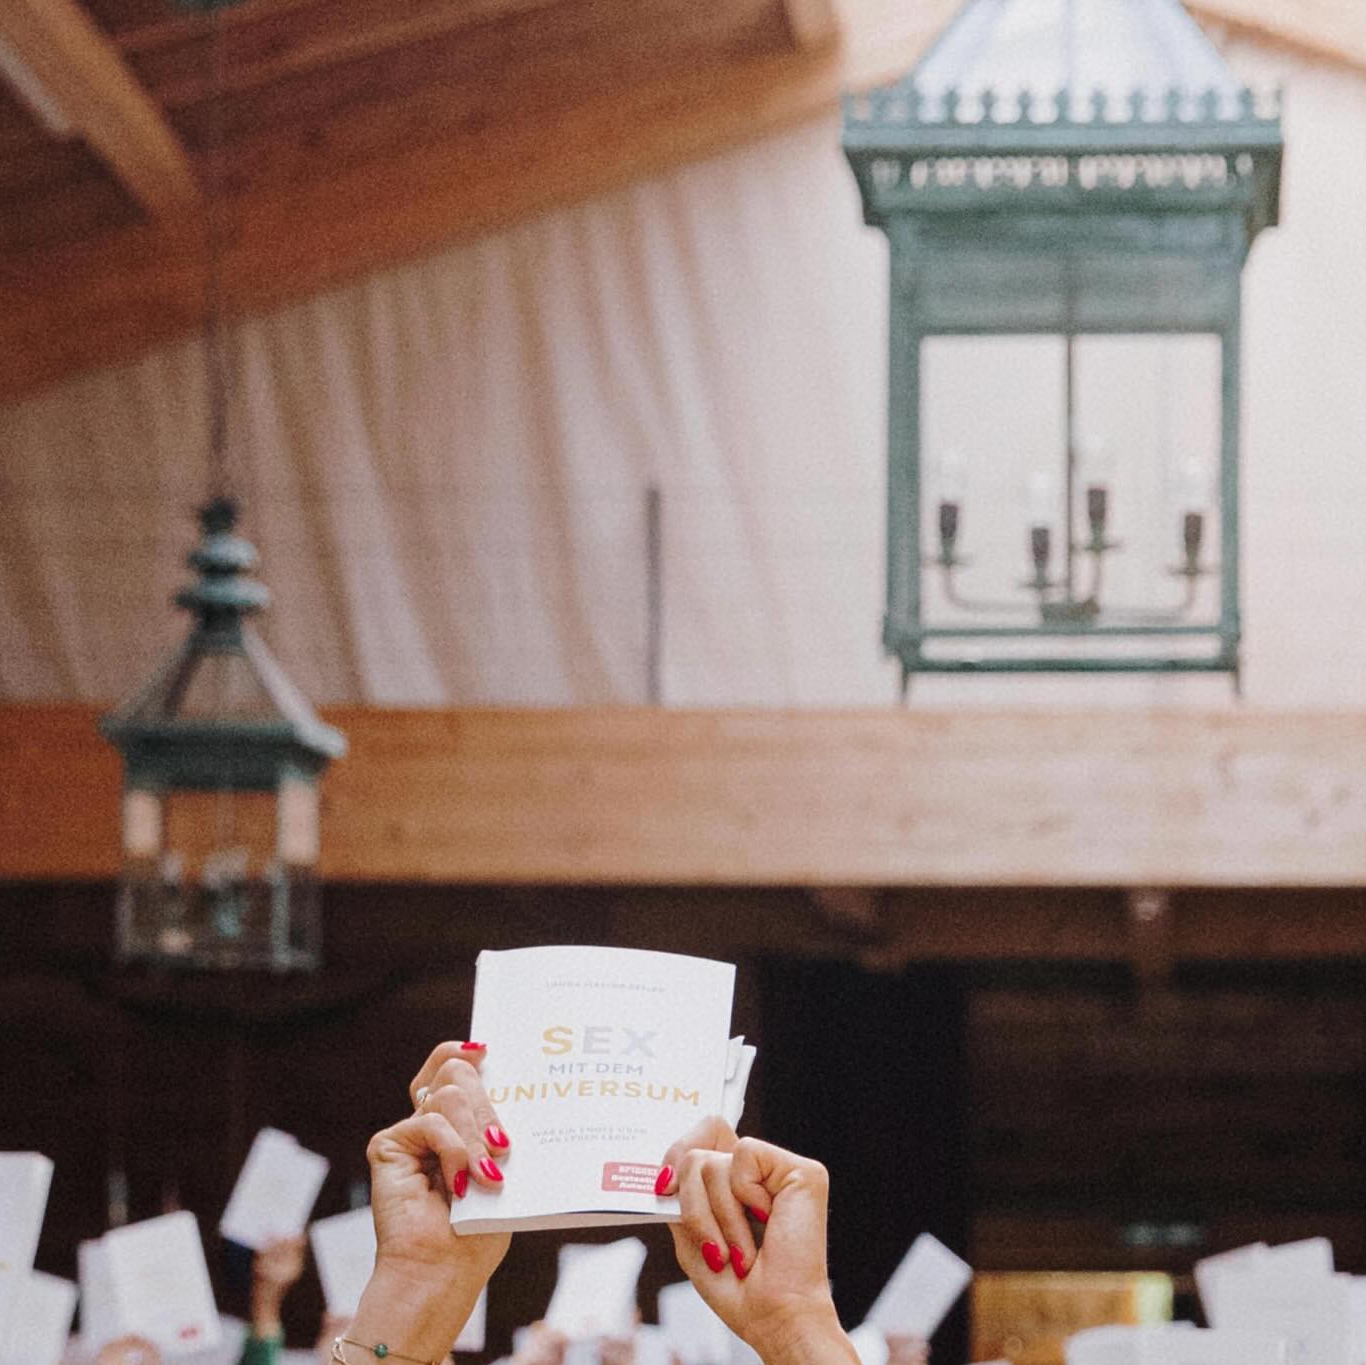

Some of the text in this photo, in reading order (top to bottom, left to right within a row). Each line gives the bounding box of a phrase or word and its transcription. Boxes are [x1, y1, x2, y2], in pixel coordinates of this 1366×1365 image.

[541, 1025, 659, 1059] SEX
[548, 1062, 644, 1076] MIT DEM
[488, 1079, 701, 1107] UNIVERSUM
